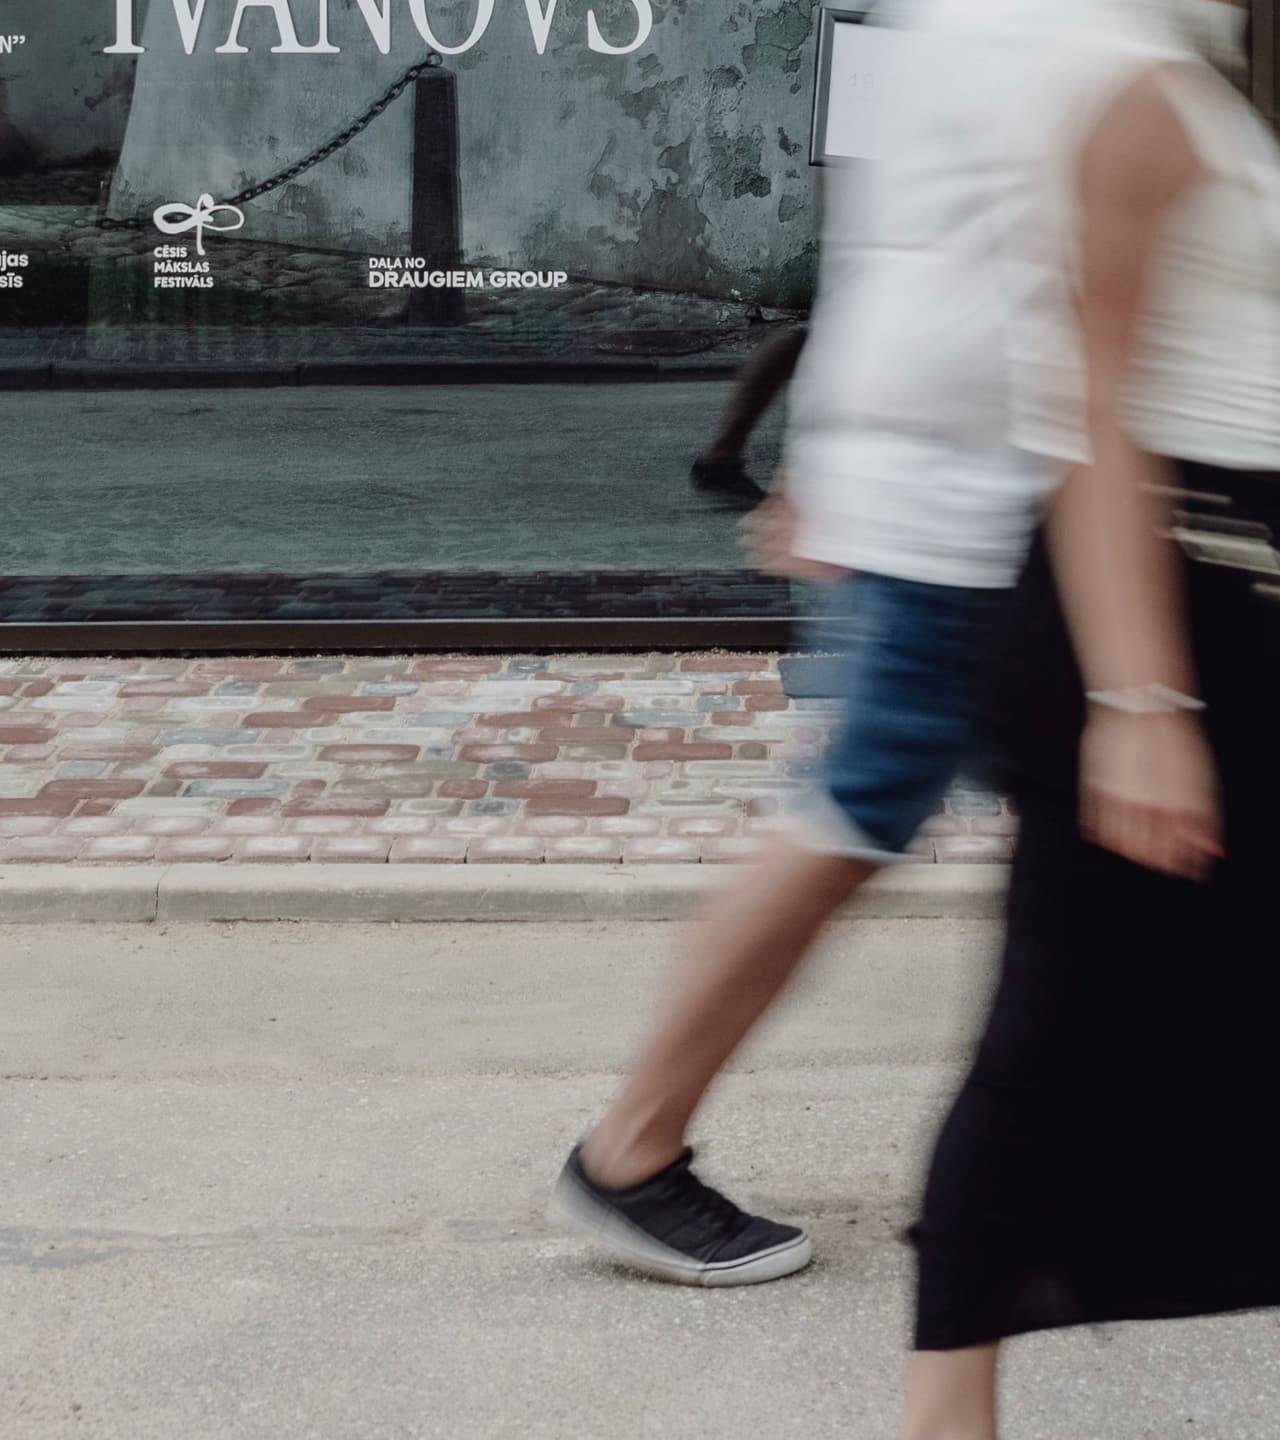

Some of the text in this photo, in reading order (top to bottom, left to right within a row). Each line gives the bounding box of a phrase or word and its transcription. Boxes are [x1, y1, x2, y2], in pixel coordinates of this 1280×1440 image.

[153, 244, 188, 258] CĒSIS
[154, 259, 210, 273] MĀKSLAS
[368, 257, 426, 271] DAĻA NO
[154, 274, 214, 288] FESTIVĀLS
[368, 271, 568, 288] DRAUGIEM GROUP
